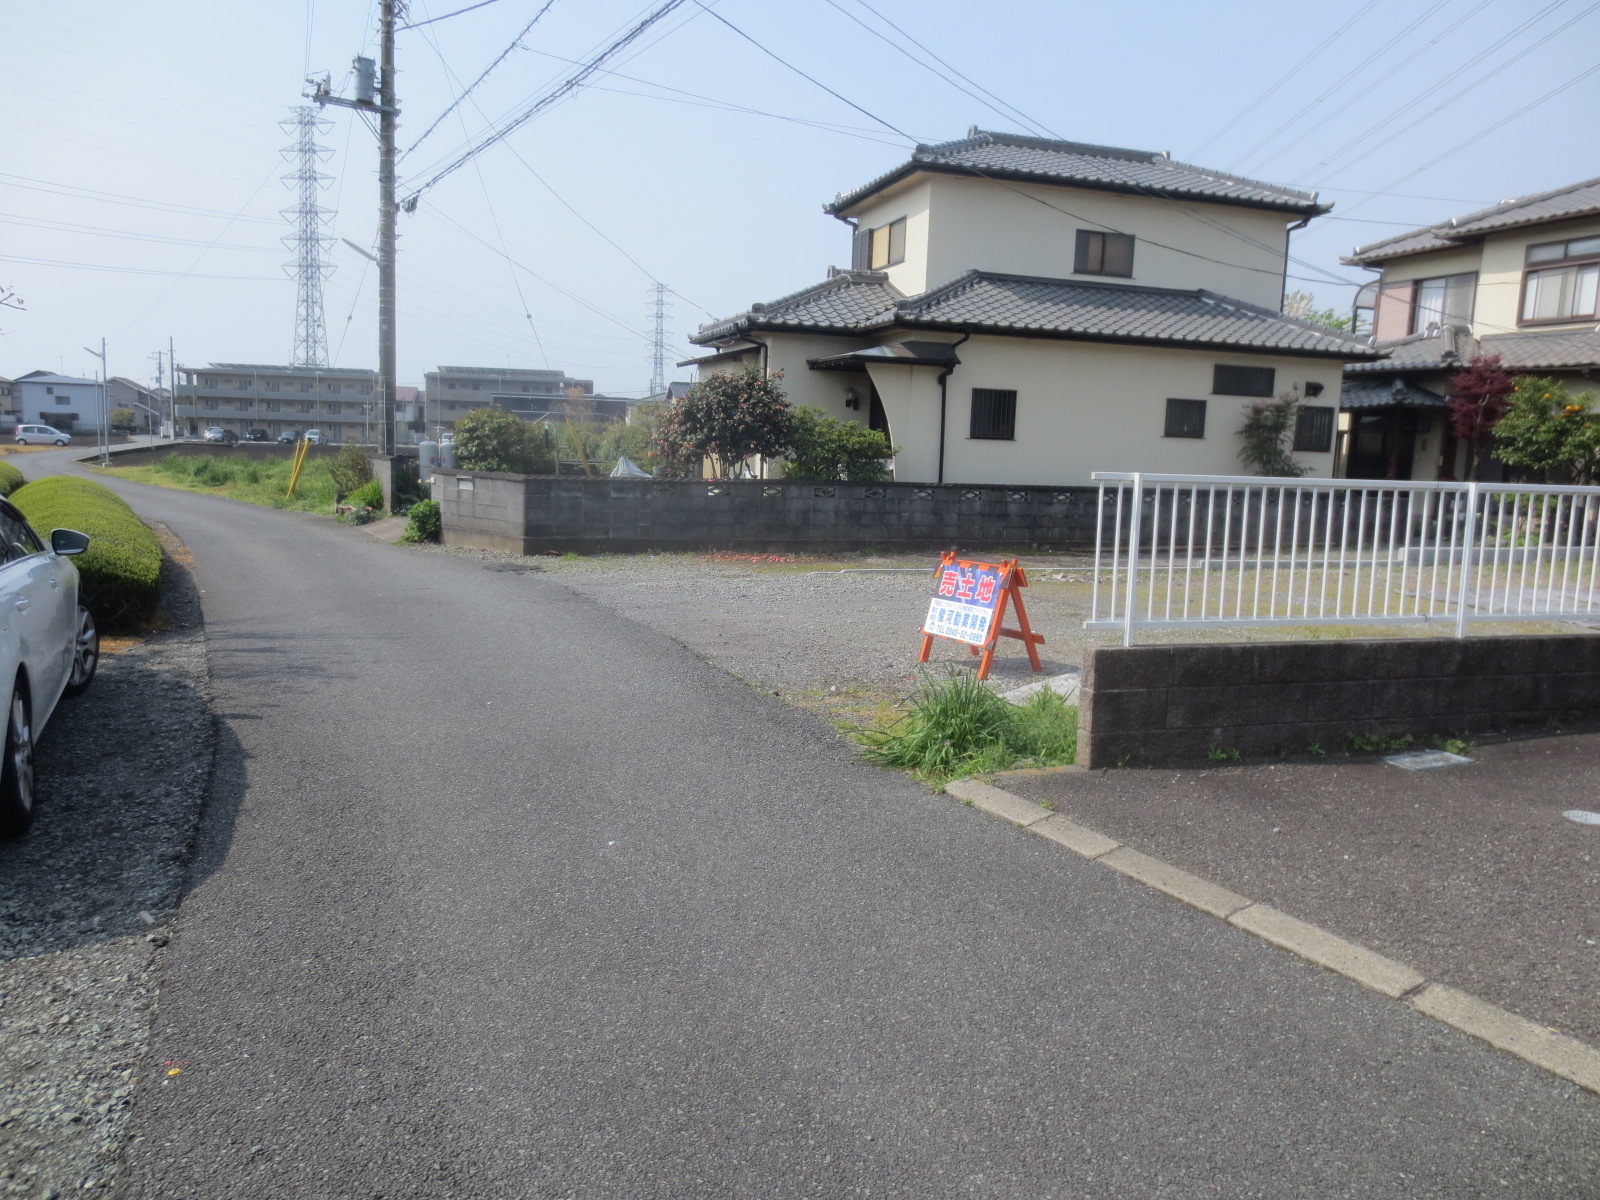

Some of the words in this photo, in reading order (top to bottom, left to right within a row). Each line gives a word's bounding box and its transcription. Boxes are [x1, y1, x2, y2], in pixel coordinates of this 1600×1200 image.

[939, 571, 995, 602] 売土地
[937, 625, 945, 634] TEL
